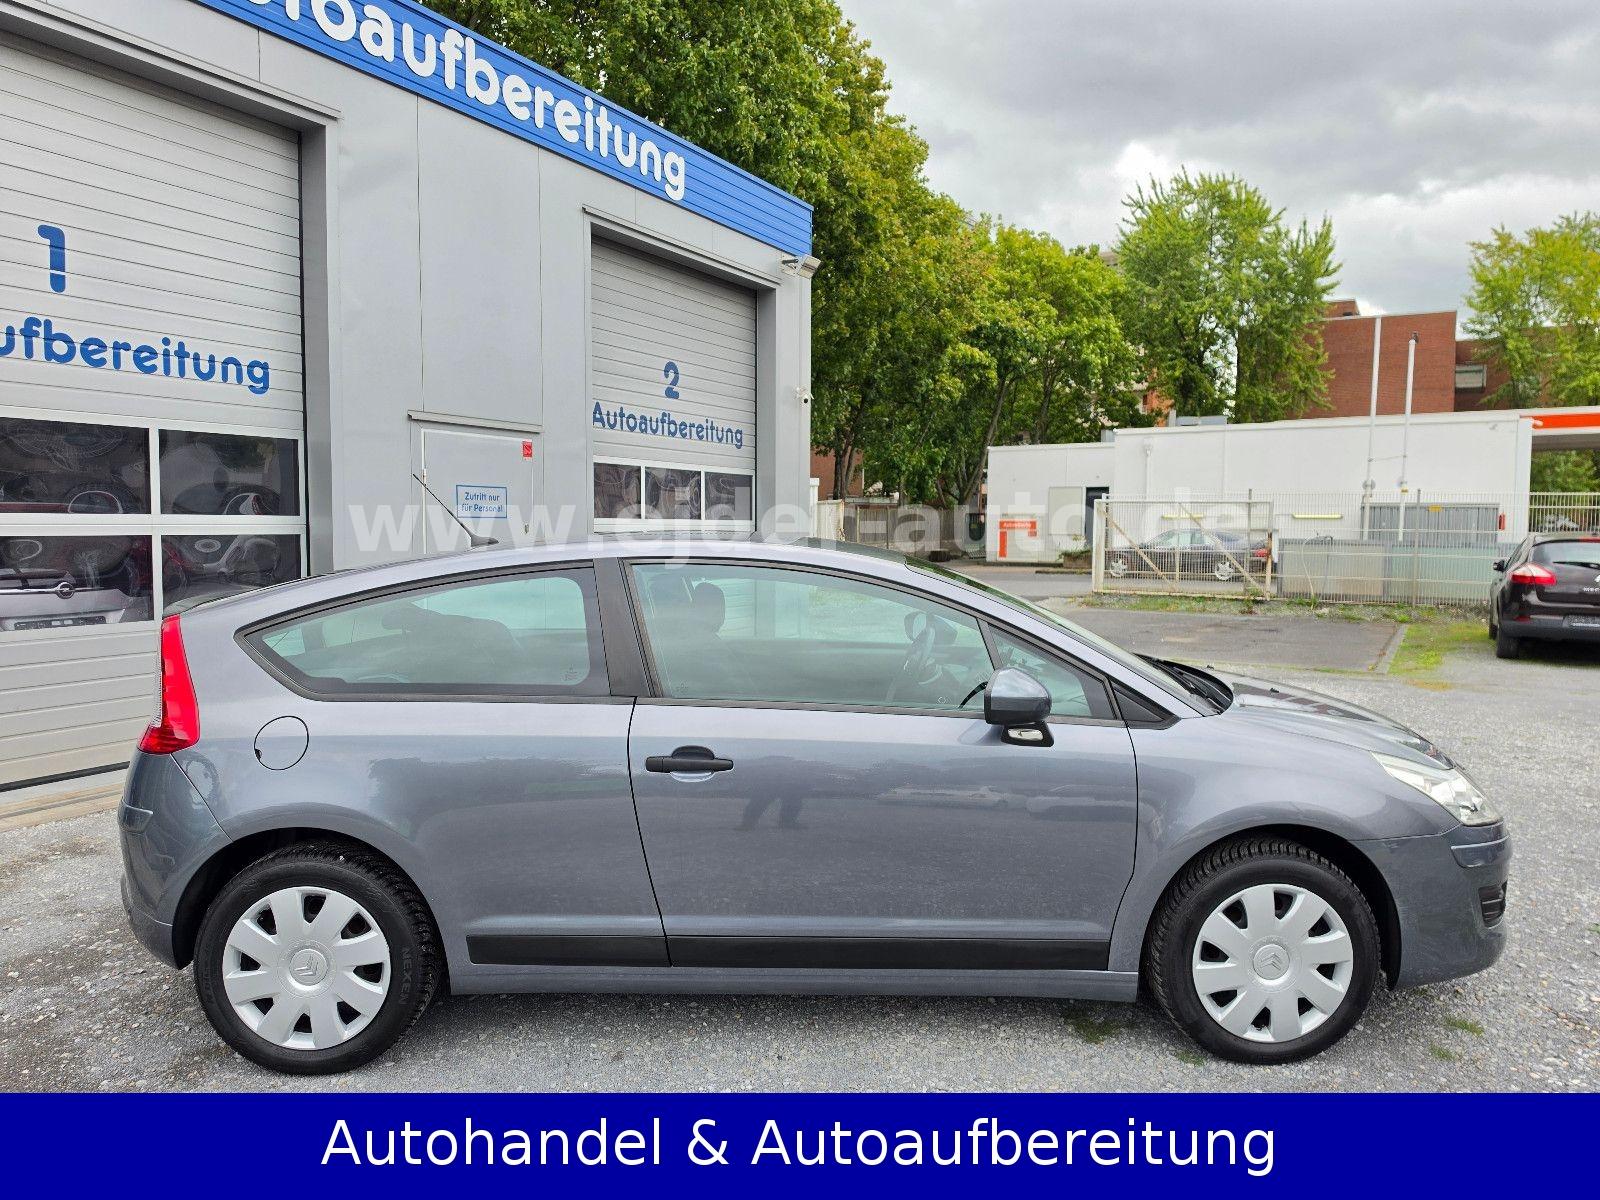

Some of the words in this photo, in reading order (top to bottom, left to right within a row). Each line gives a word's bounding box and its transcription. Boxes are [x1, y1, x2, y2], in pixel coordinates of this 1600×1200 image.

[38, 225, 65, 293] 1
[664, 361, 680, 399] 2
[592, 401, 743, 449] Autoaufbereitung
[461, 503, 471, 512] für
[473, 503, 503, 512] Personal
[464, 492, 487, 501] Zutritt
[488, 494, 500, 502] nur
